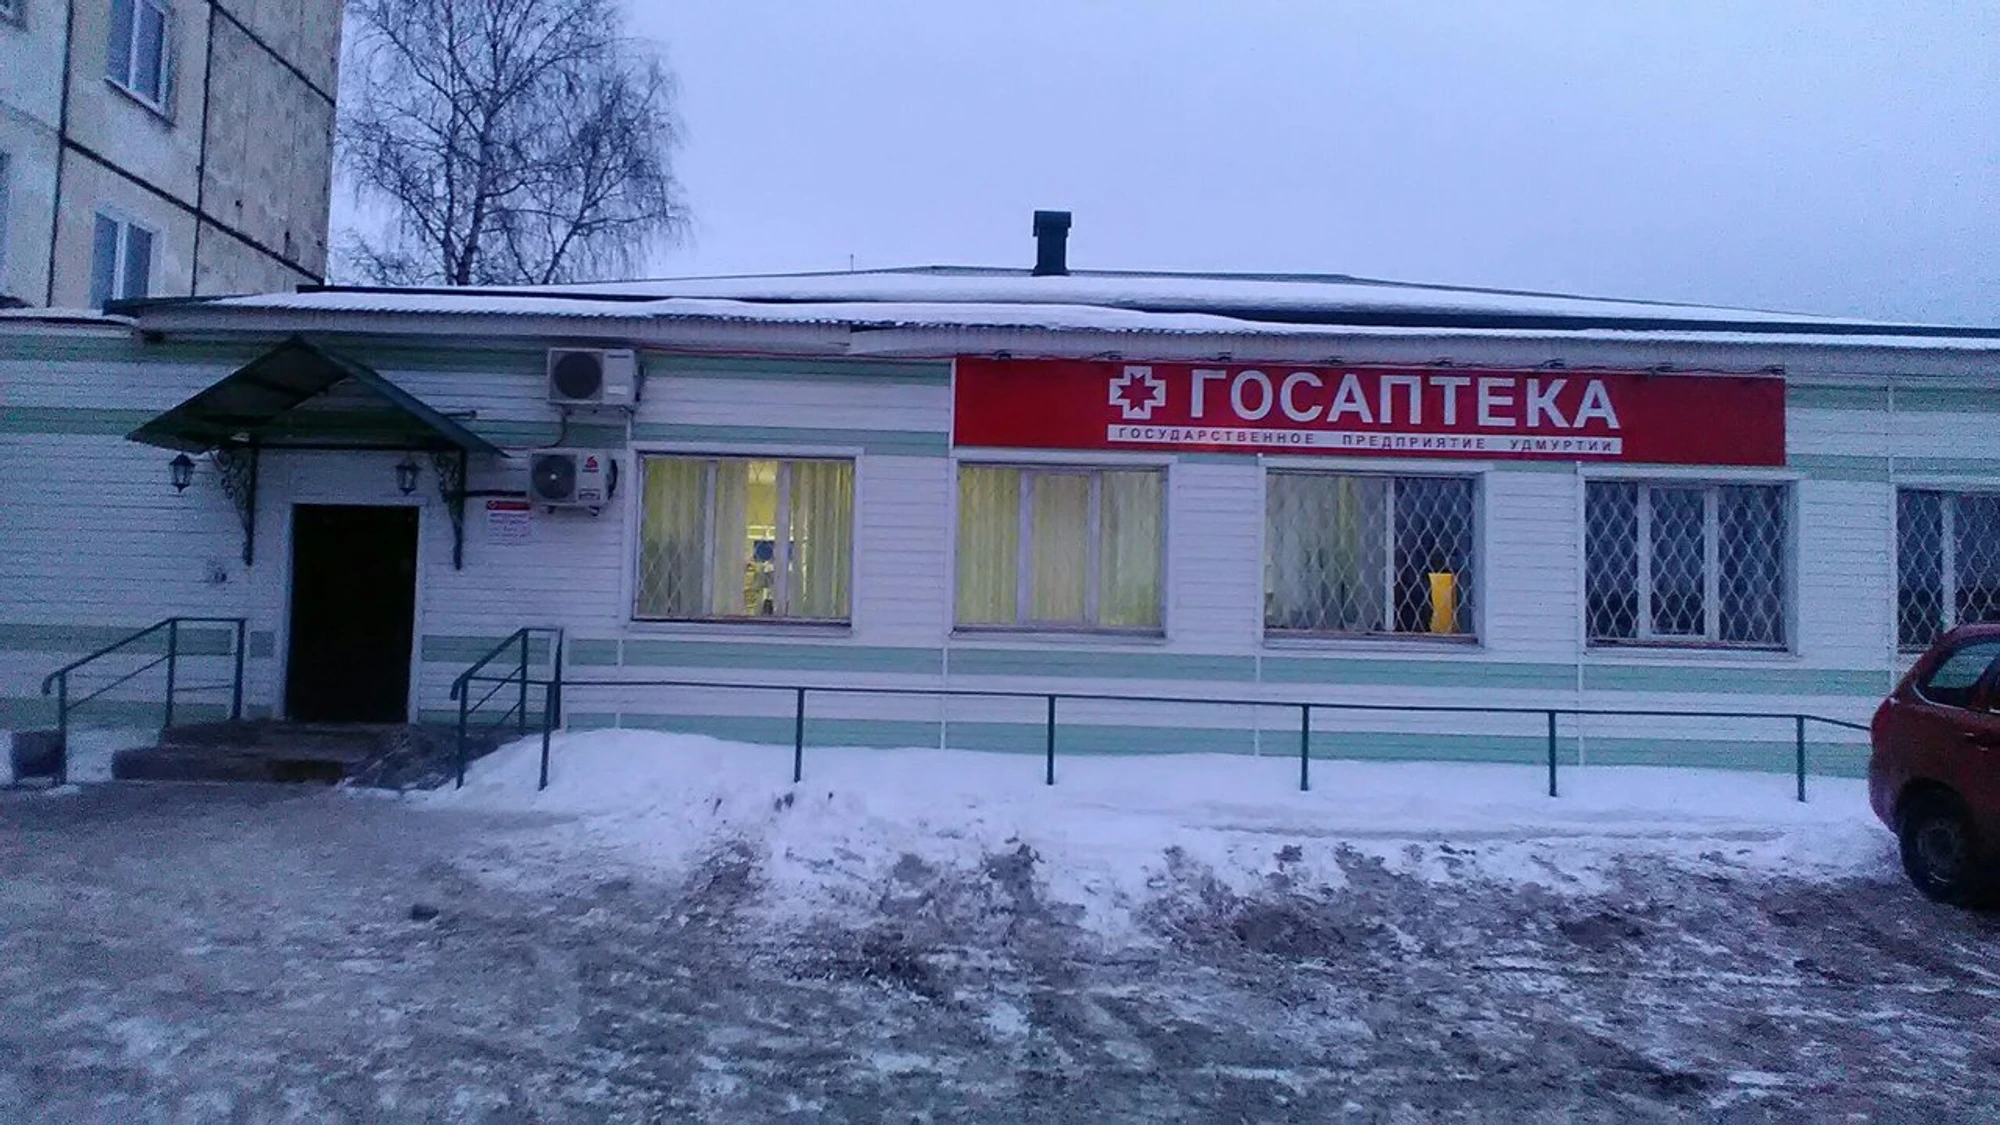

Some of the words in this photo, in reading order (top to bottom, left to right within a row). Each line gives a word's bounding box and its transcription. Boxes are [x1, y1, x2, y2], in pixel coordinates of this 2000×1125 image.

[1190, 369, 1621, 429] ГОСАПТЕКА
[1119, 428, 1314, 444] ГОСУДАРСТВЕННОЕ
[1342, 435, 1486, 449] ПРЕДПРИЯТИЕ
[1510, 439, 1613, 452] УДМУРТИИ
